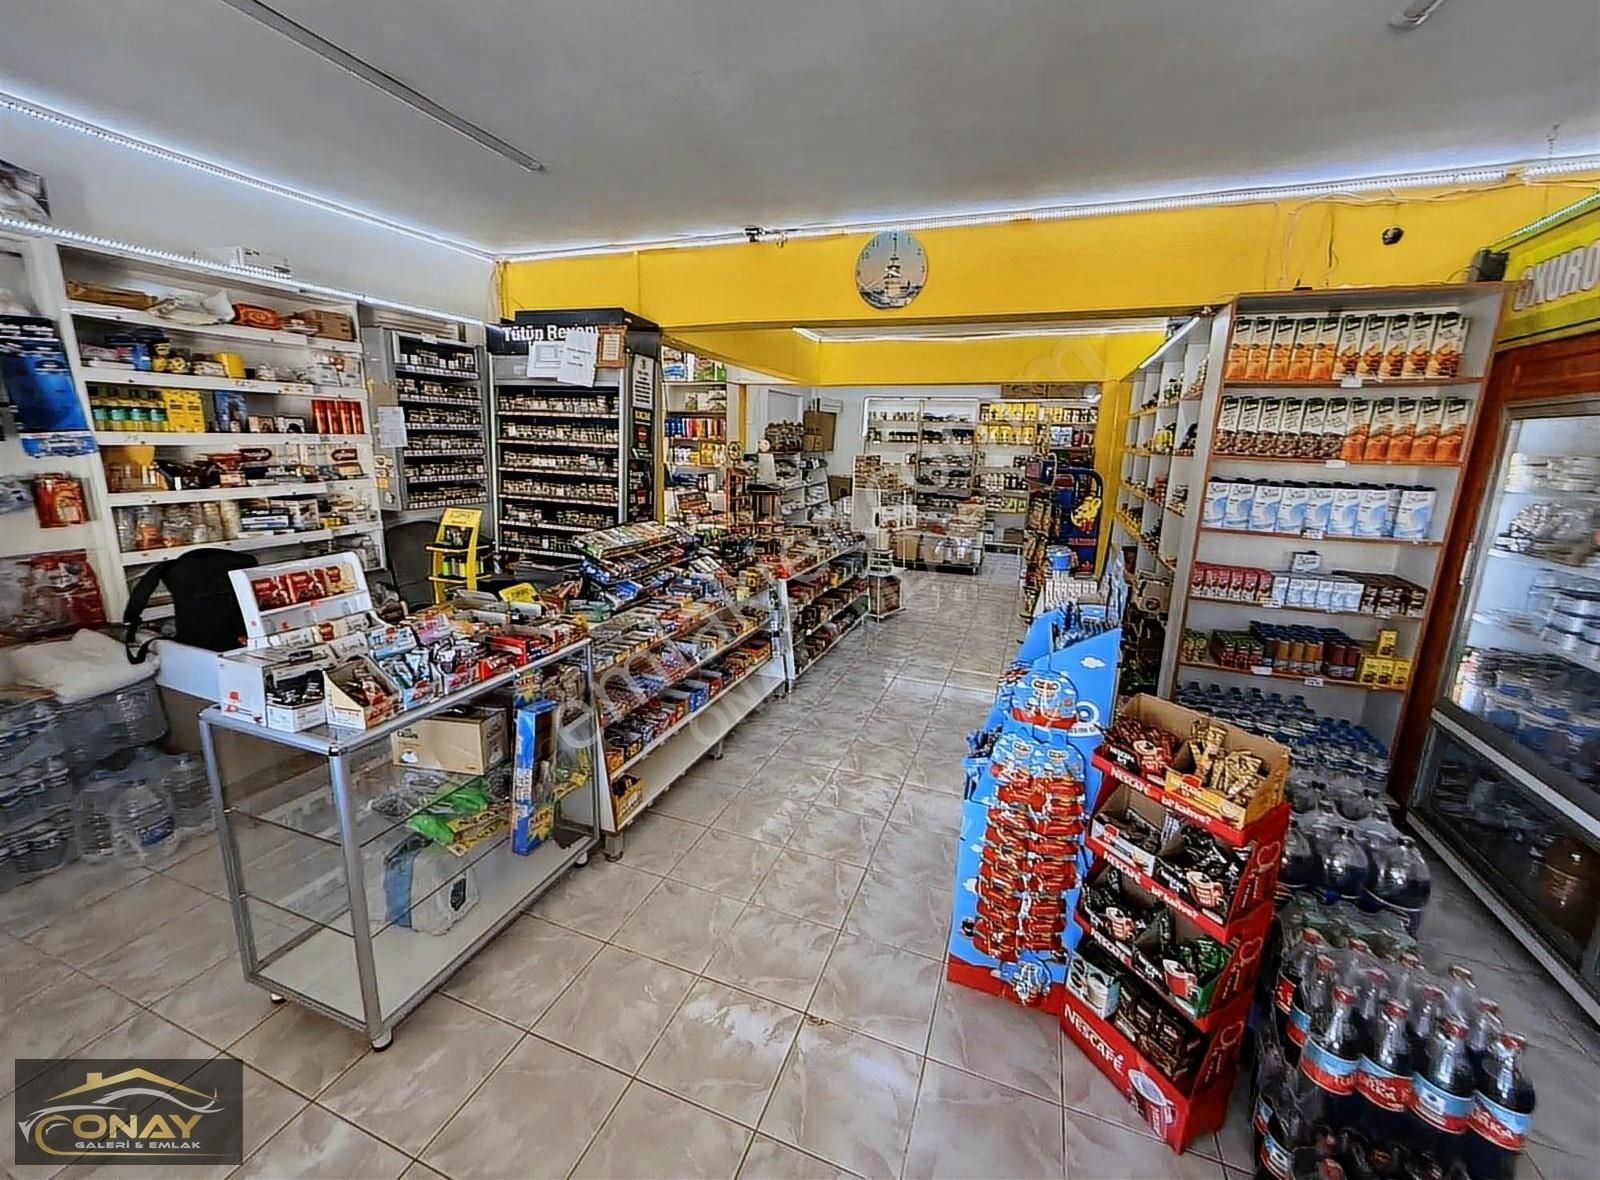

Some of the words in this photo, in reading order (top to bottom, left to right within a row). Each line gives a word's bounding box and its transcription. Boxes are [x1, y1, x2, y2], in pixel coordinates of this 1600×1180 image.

[502, 325, 544, 342] Tütün
[547, 324, 598, 341] Reon
[1063, 1003, 1126, 1077] NESCAFÉ
